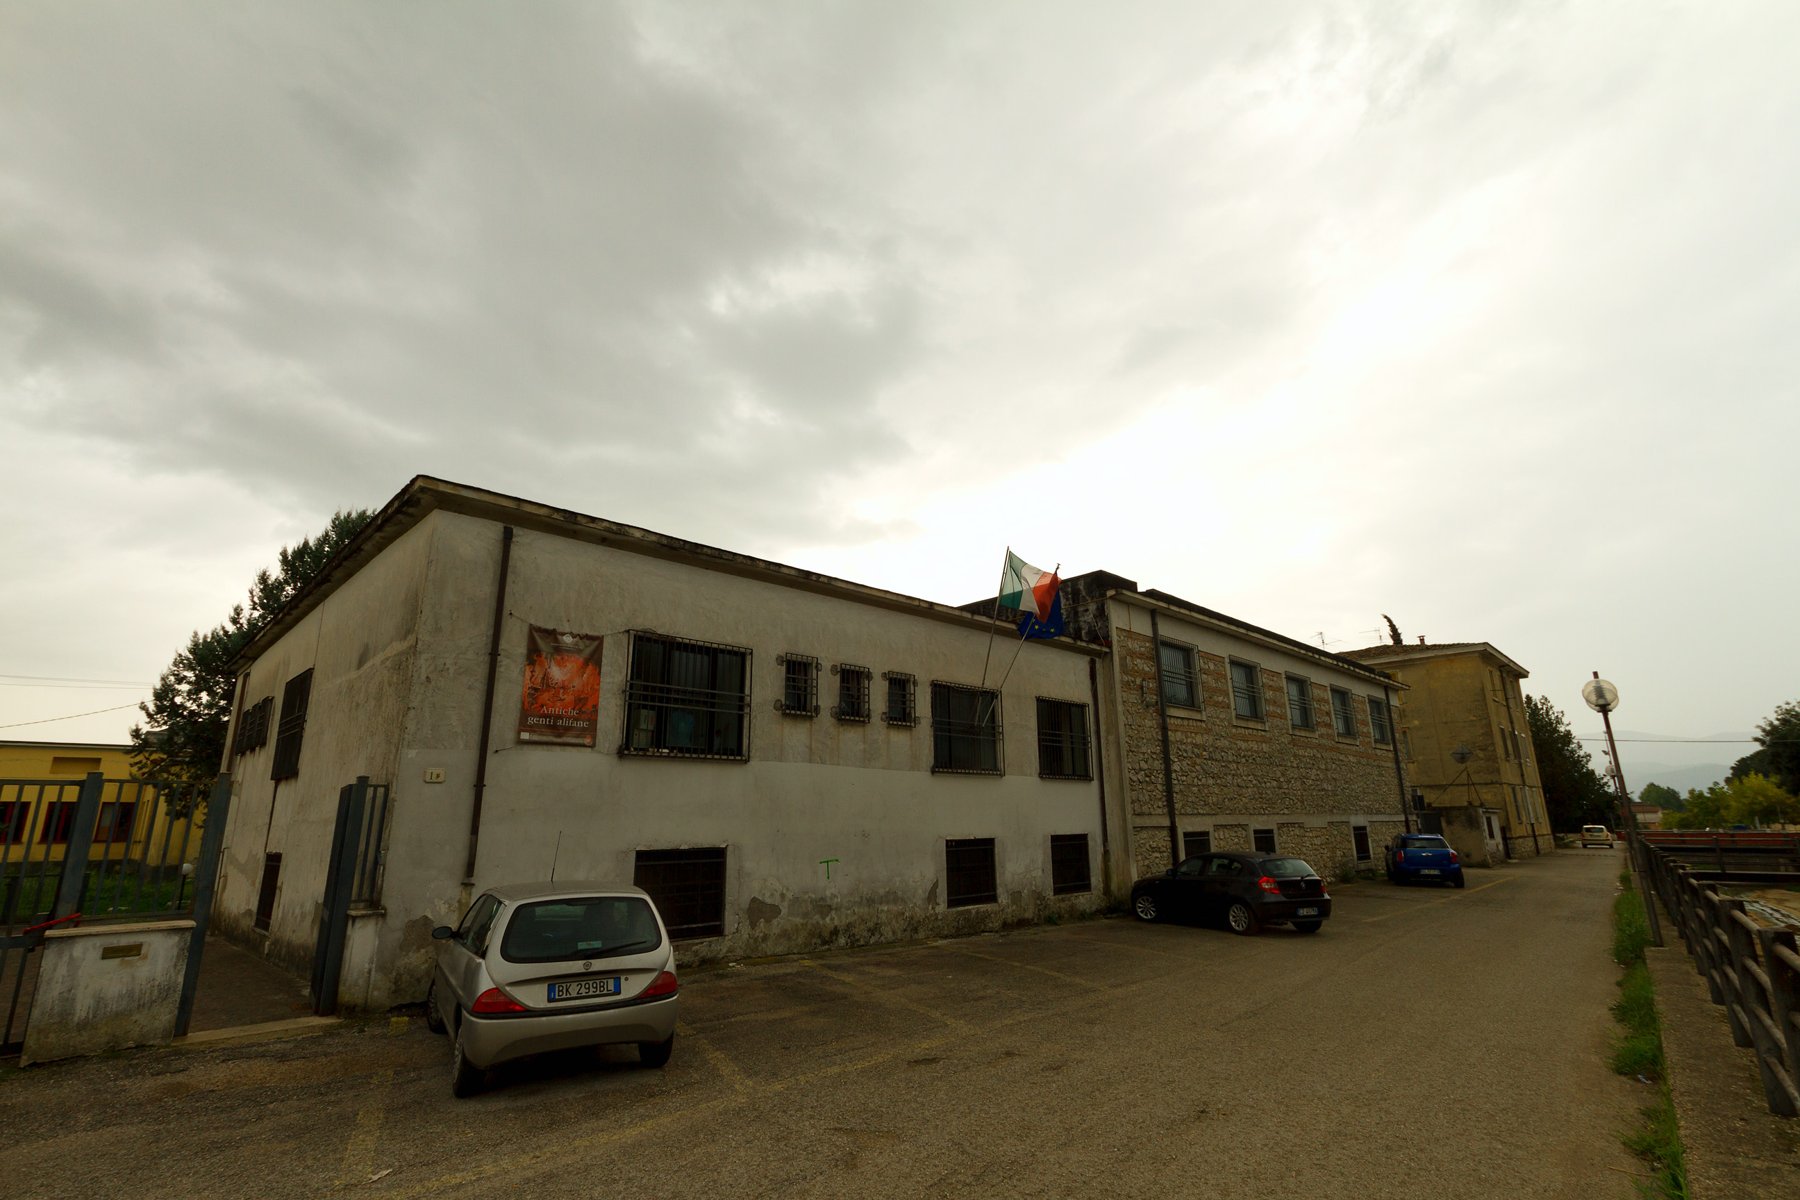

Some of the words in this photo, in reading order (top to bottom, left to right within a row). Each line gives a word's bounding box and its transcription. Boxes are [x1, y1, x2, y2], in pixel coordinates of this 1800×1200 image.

[540, 705, 579, 716] Antiche
[527, 716, 554, 725] genti
[556, 717, 589, 727] alifane
[557, 984, 571, 997] BK
[576, 980, 612, 994] 299BL
